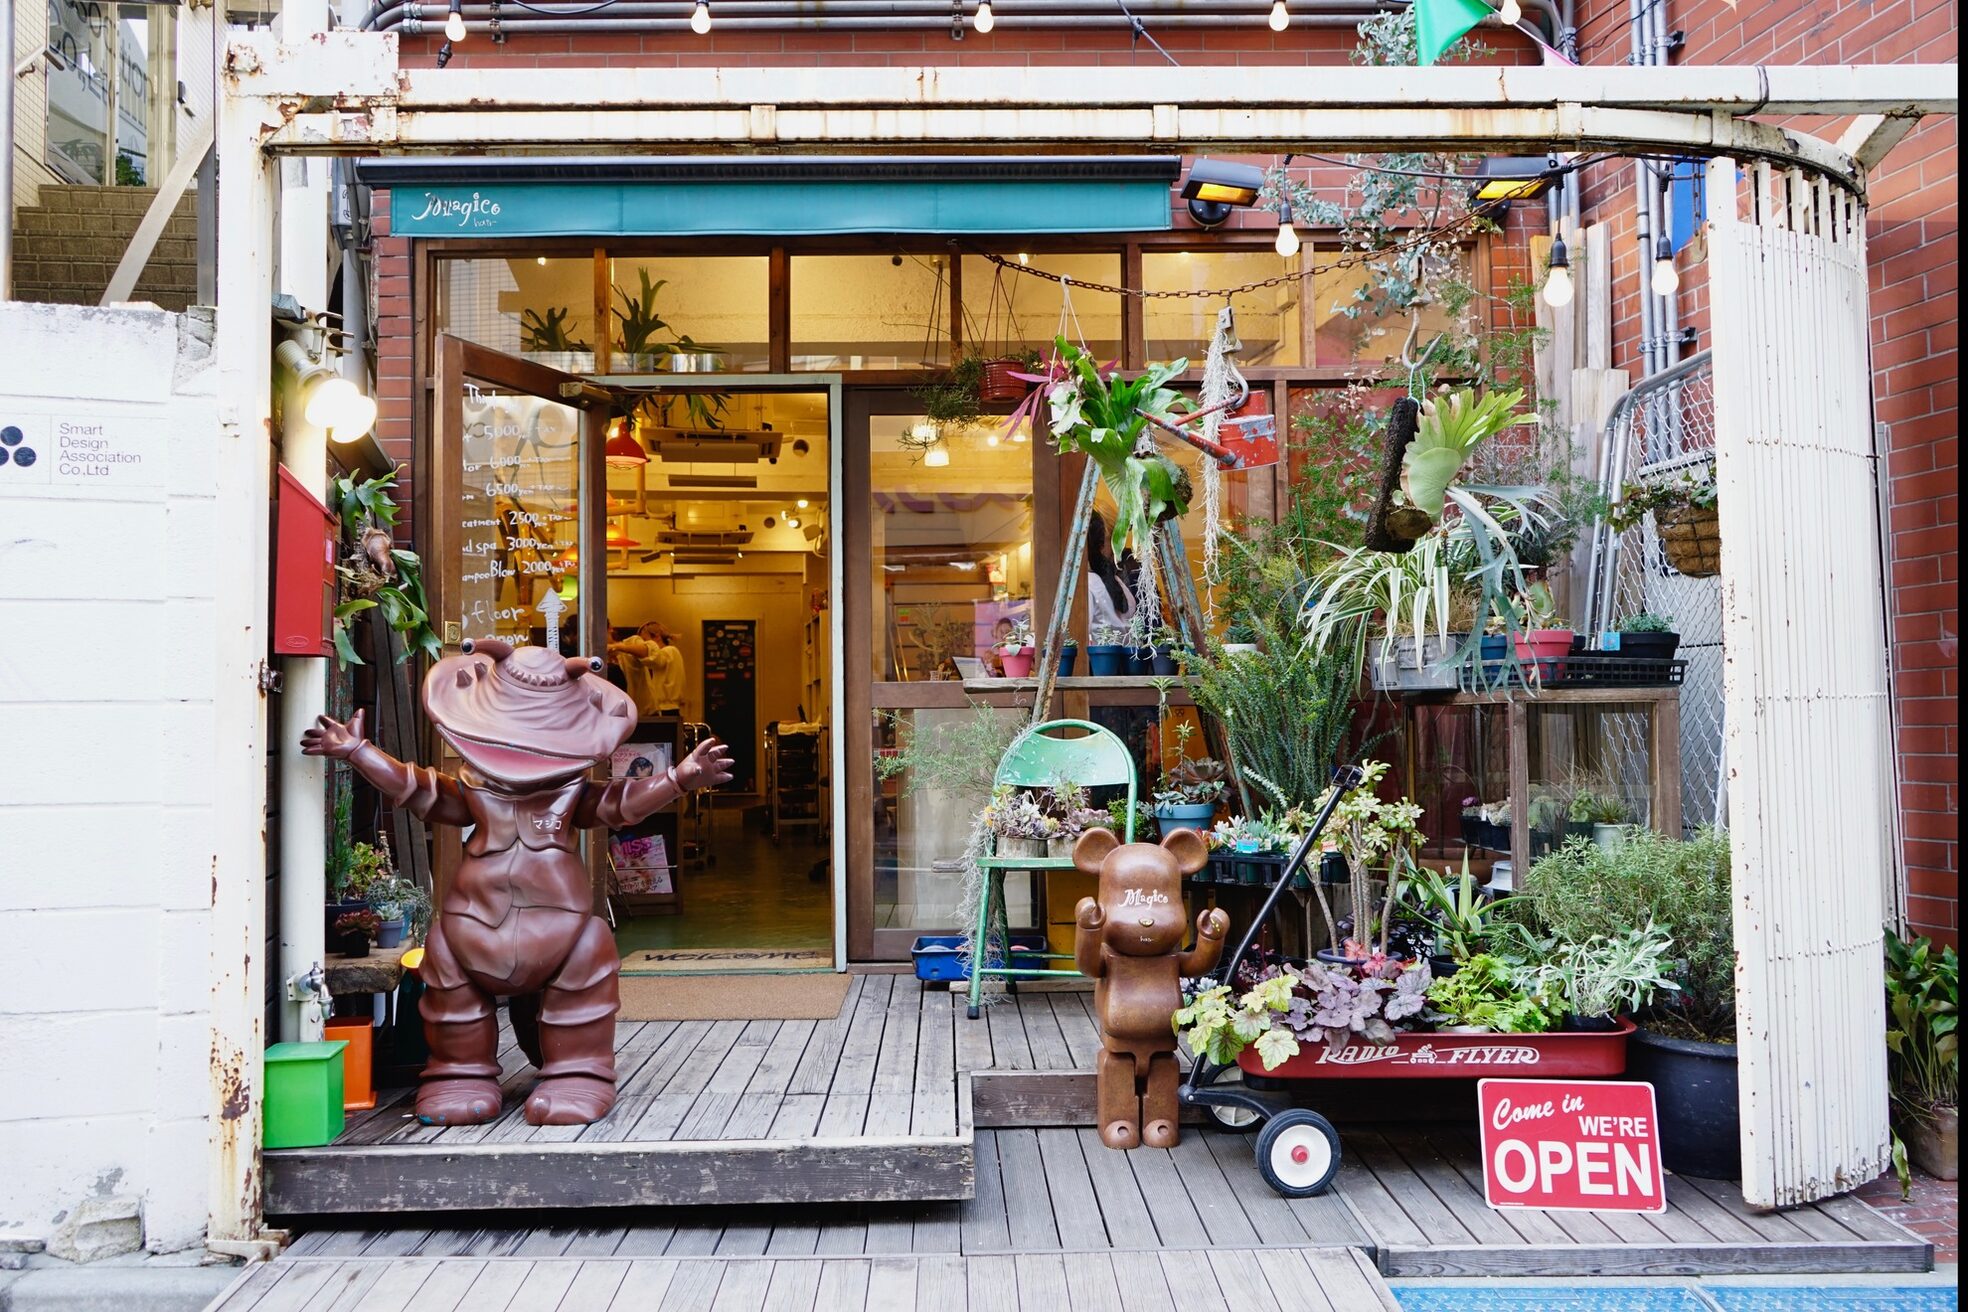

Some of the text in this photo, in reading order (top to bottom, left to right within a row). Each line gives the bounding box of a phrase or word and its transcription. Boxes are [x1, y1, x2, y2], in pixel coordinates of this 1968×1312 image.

[59, 422, 103, 436] Smart
[60, 436, 109, 452] Design
[59, 449, 142, 464] Association
[471, 600, 525, 625] floor
[1117, 888, 1169, 910] Magico
[644, 951, 817, 962] welcome
[1315, 1045, 1541, 1065] RADIO FLYER
[1492, 1093, 1586, 1131] Come in
[1578, 1115, 1650, 1138] WE'RE
[1493, 1138, 1655, 1198] OPEN
